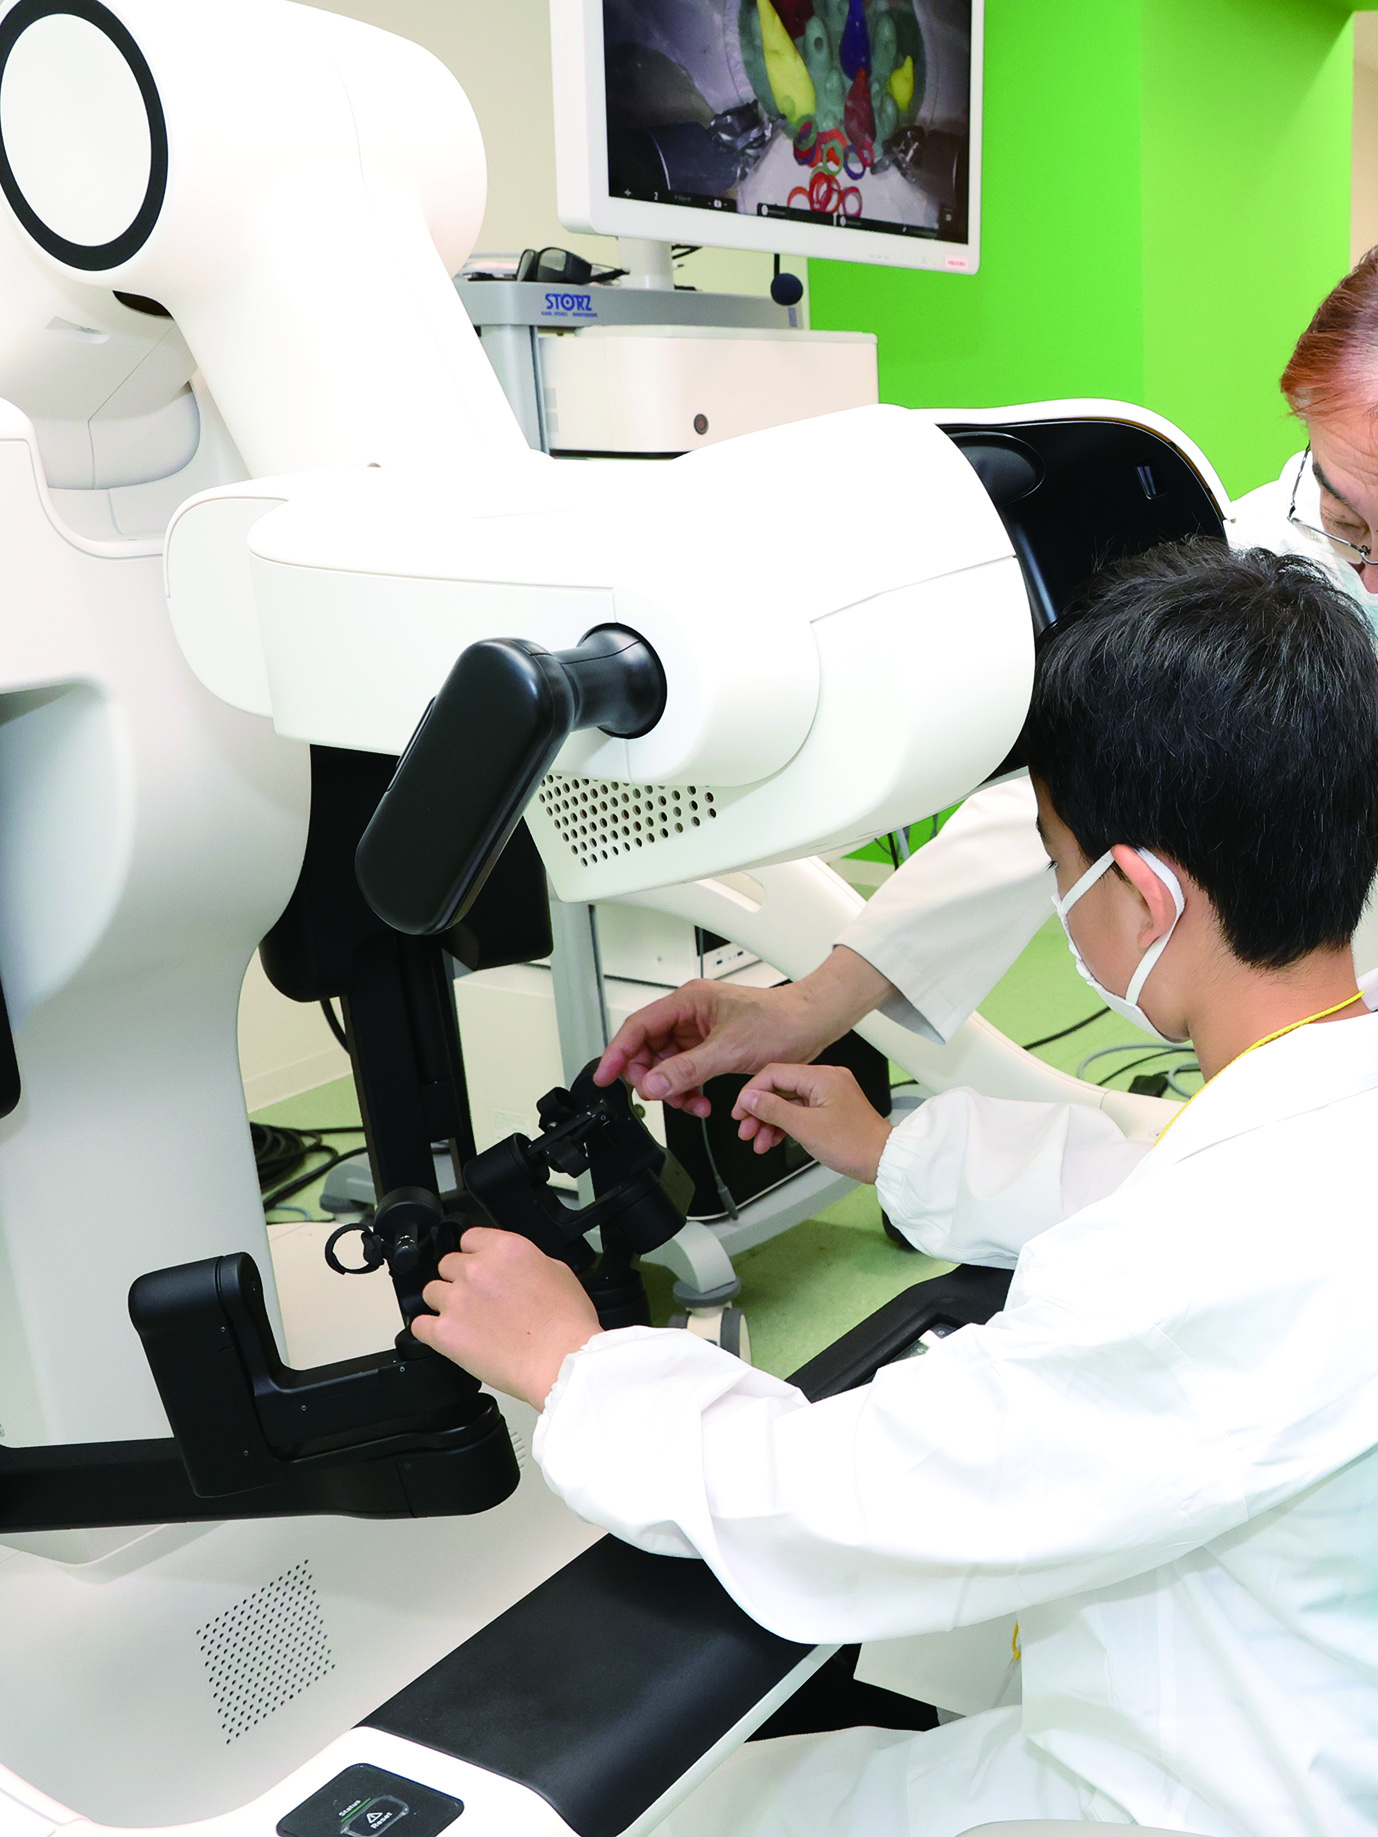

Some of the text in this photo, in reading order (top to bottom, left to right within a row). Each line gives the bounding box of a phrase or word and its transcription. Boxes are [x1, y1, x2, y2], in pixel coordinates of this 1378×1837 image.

[545, 293, 592, 311] STORZ
[338, 1799, 361, 1817] Status
[370, 1811, 393, 1829] Reset
